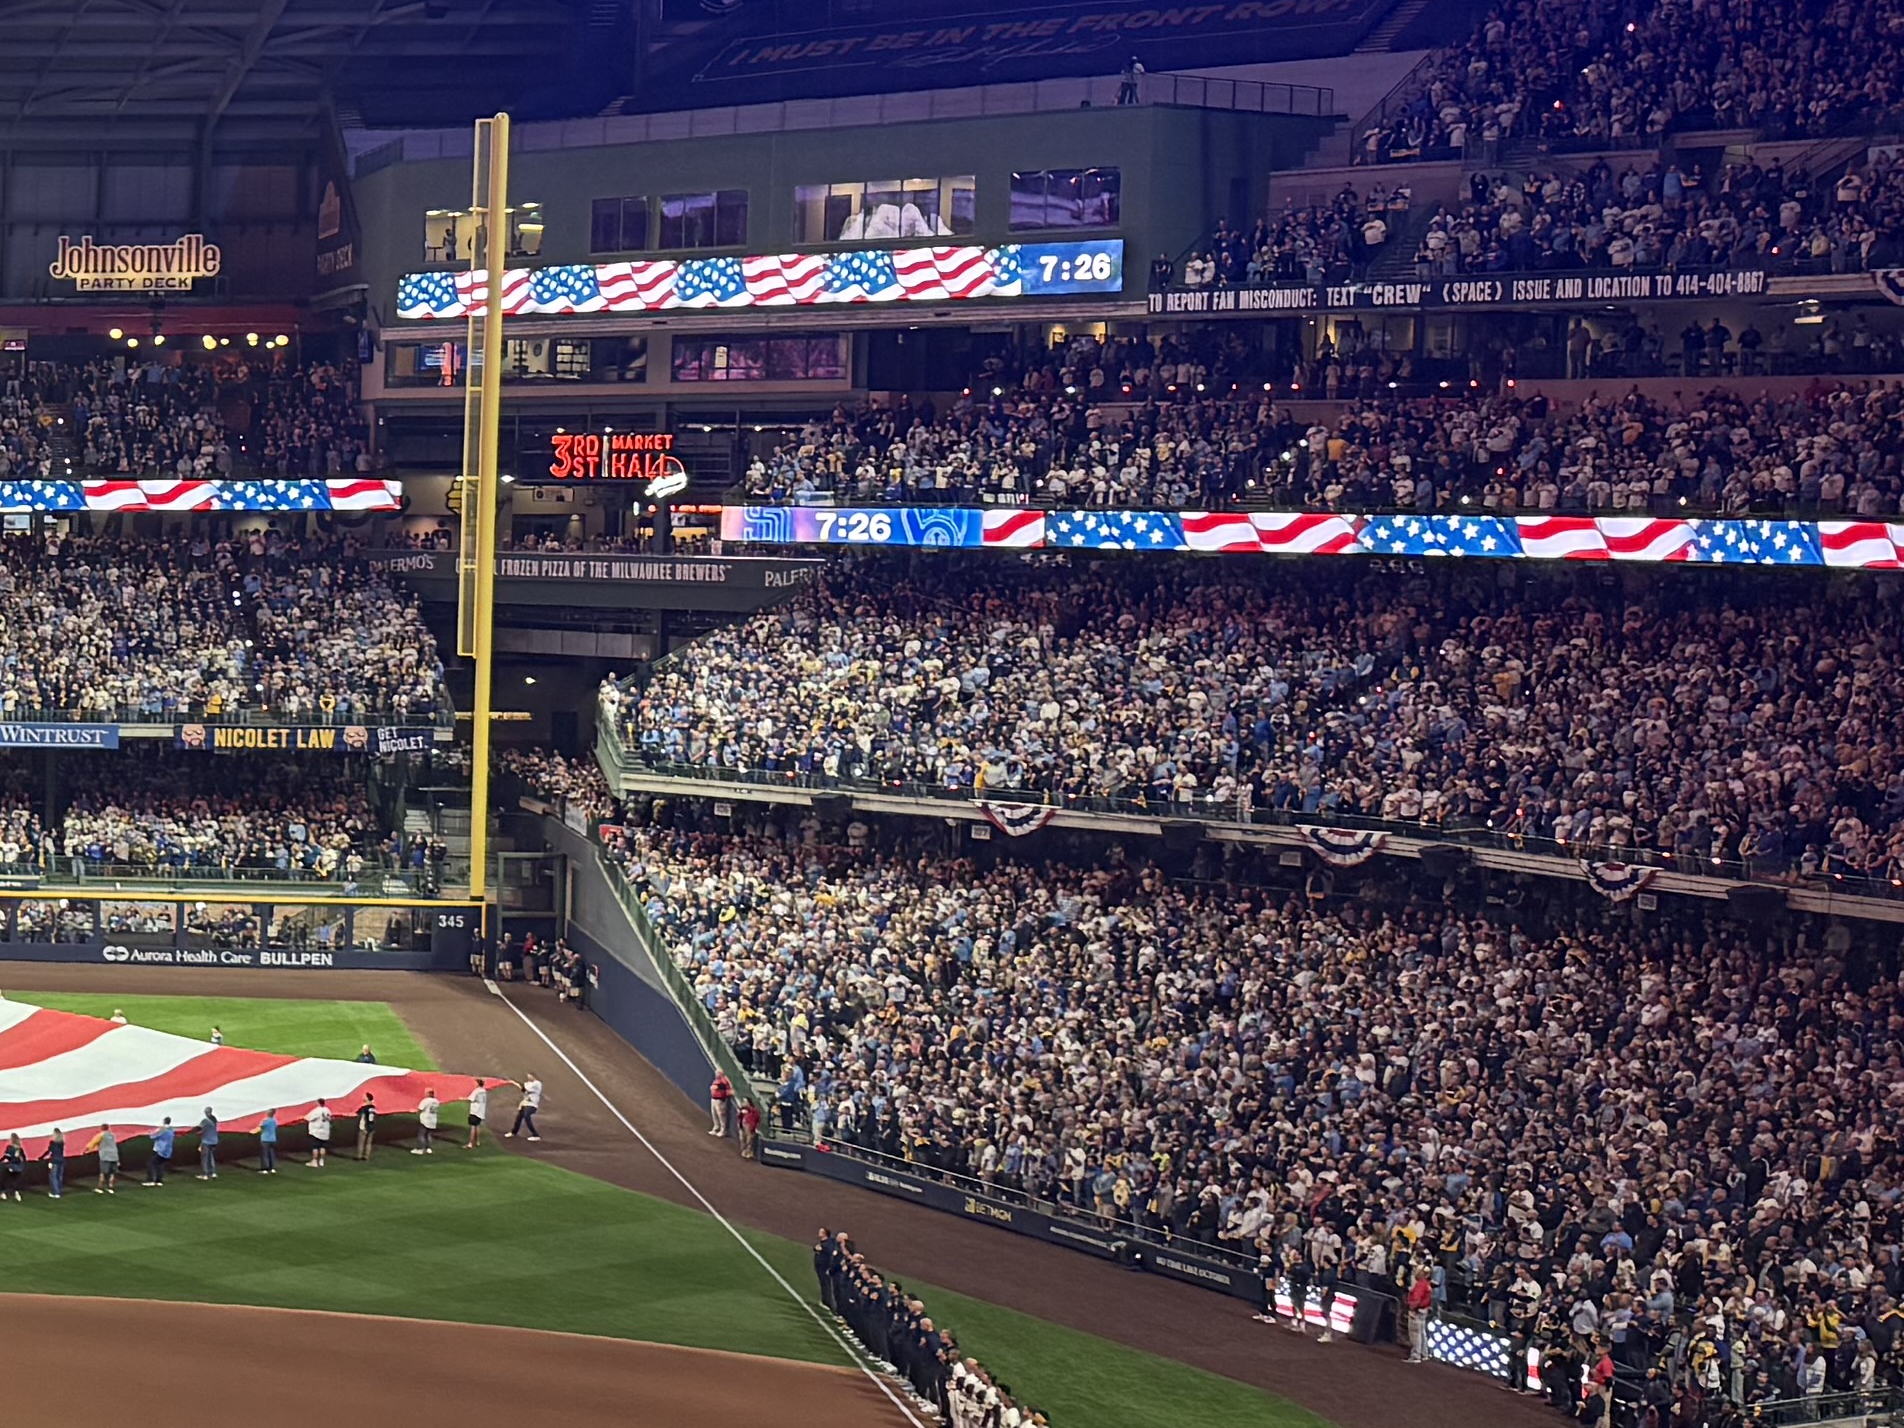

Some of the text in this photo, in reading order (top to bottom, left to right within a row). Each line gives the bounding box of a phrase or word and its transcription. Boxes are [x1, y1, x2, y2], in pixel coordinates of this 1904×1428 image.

[1068, 5, 1217, 32] FRONT
[50, 235, 220, 277] Johnsonville
[1039, 252, 1111, 282] 7:26
[79, 277, 189, 289] PARTY DECK
[1148, 293, 1162, 313] TO
[1167, 291, 1209, 312] REPORT
[1326, 287, 1357, 307] TEXT
[1512, 280, 1551, 300] ISSUE
[1555, 279, 1583, 299] AND
[1588, 277, 1653, 297] LOCATION
[1656, 276, 1672, 296] TO
[612, 434, 673, 450] MARKET
[815, 512, 892, 541] 7:26
[501, 559, 539, 577] FROZEN
[542, 560, 571, 577] PIZZA
[573, 561, 587, 577] OF
[589, 561, 608, 578] THE
[612, 562, 672, 580] MILWAUKEE
[675, 563, 726, 581] BREWERS
[214, 728, 336, 749] NICOLET LAW
[377, 727, 397, 740] GET
[438, 914, 465, 928] 345
[130, 949, 333, 966] Aurora Health Care BULLPEN
